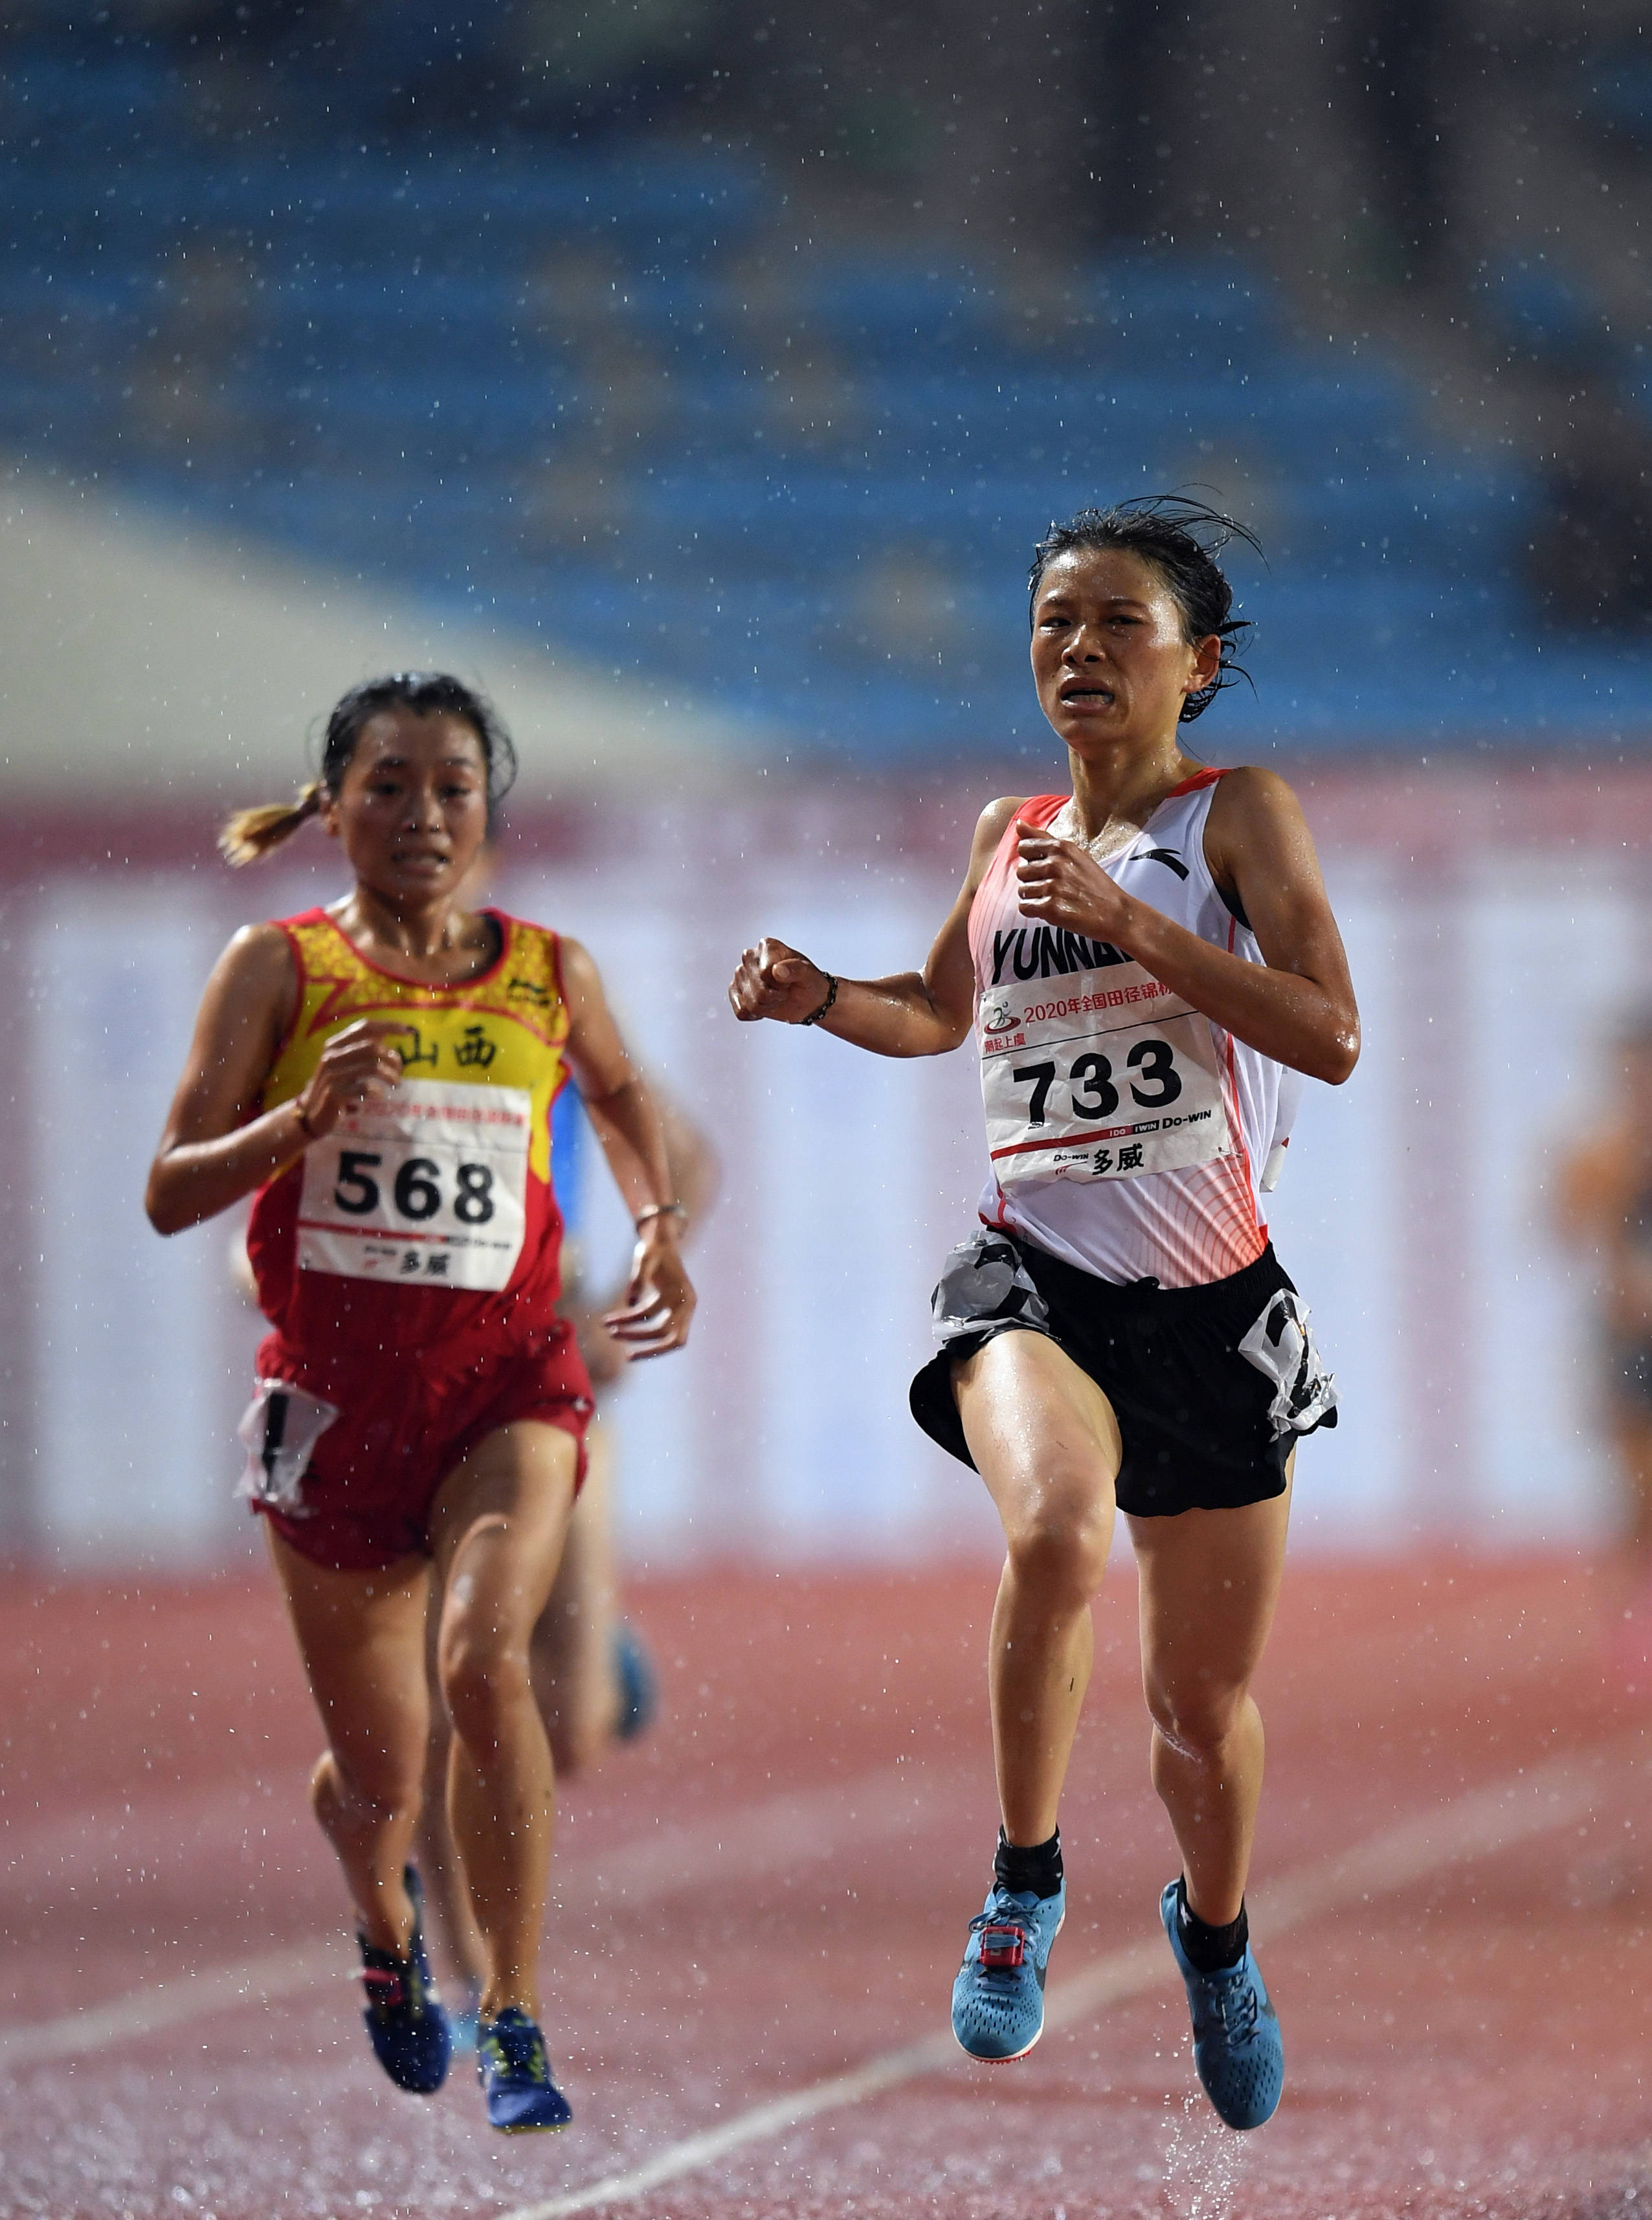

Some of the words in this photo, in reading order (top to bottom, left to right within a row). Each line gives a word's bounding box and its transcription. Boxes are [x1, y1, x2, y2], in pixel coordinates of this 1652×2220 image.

[991, 926, 1135, 985] YUNNA
[396, 1026, 497, 1070] 山西
[1012, 1039, 1182, 1130] 733
[335, 1151, 495, 1225] 568
[1092, 1143, 1144, 1175] 多威
